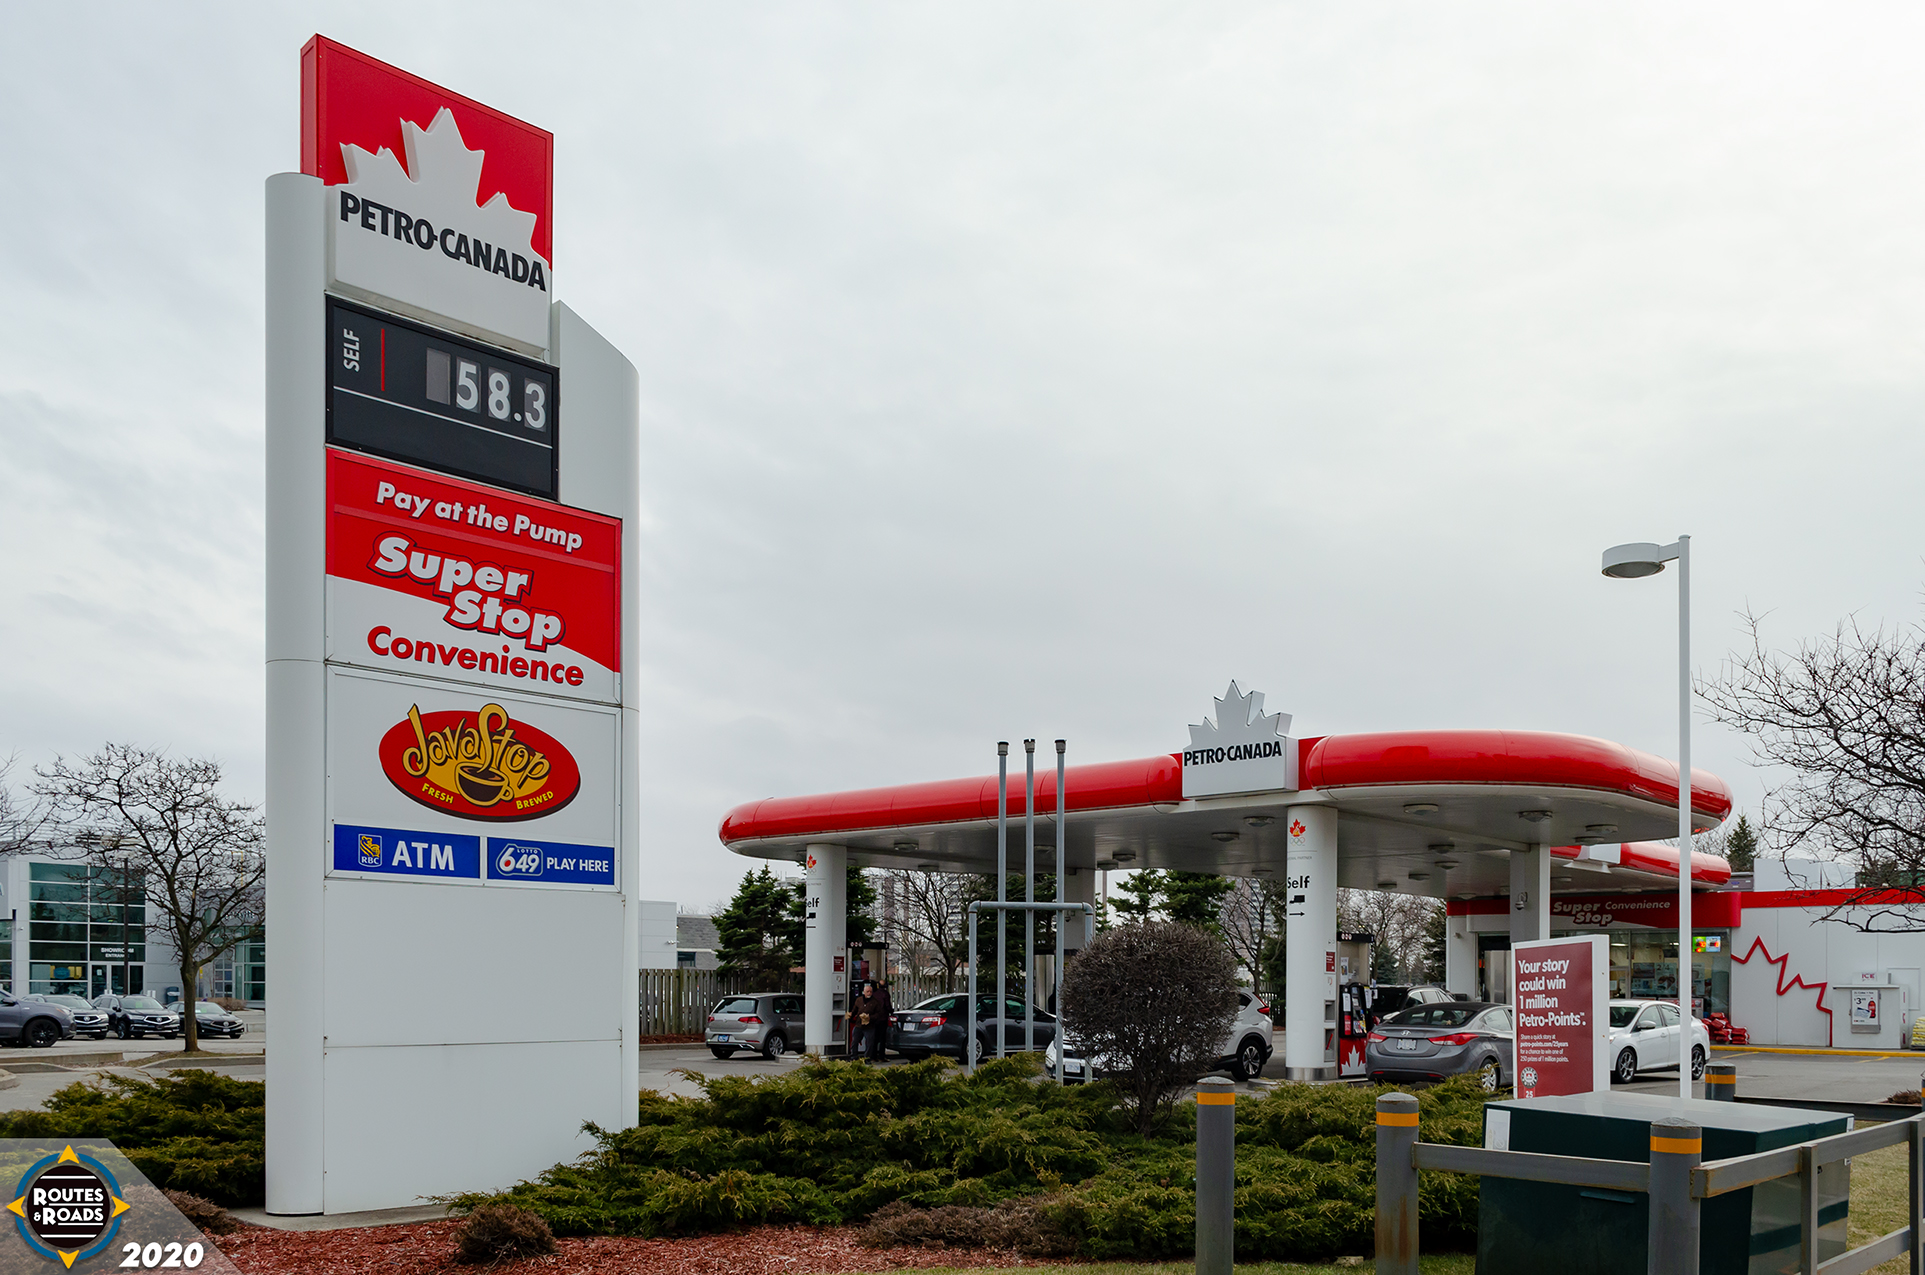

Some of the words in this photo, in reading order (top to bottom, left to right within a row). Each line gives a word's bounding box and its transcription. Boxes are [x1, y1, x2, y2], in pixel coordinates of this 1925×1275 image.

[340, 190, 547, 292] PETRO-CANADA
[343, 328, 360, 372] SELF
[456, 361, 546, 429] 58.3
[376, 481, 431, 518] Pay
[434, 500, 463, 521] at
[467, 504, 509, 532] the
[513, 514, 583, 553] Pump
[374, 536, 529, 596] Super
[450, 590, 562, 646] Stop
[367, 625, 584, 686] Convenience
[1183, 740, 1283, 767] PETRO-CANADA
[421, 782, 454, 804] FRESH
[515, 791, 554, 810] BREWED
[361, 856, 380, 865] RBC
[391, 840, 455, 871] ATM
[546, 857, 576, 871] PLAY
[579, 859, 609, 873] HERE
[806, 897, 820, 908] elf
[1552, 901, 1601, 915] Super
[1604, 900, 1671, 910] Convenience
[1574, 912, 1613, 925] Stop
[1518, 959, 1541, 974] Your
[1541, 958, 1570, 974] story
[1519, 975, 1546, 992] could
[1546, 974, 1567, 990] win
[1519, 995, 1524, 1010] 1
[1525, 993, 1559, 1009] million
